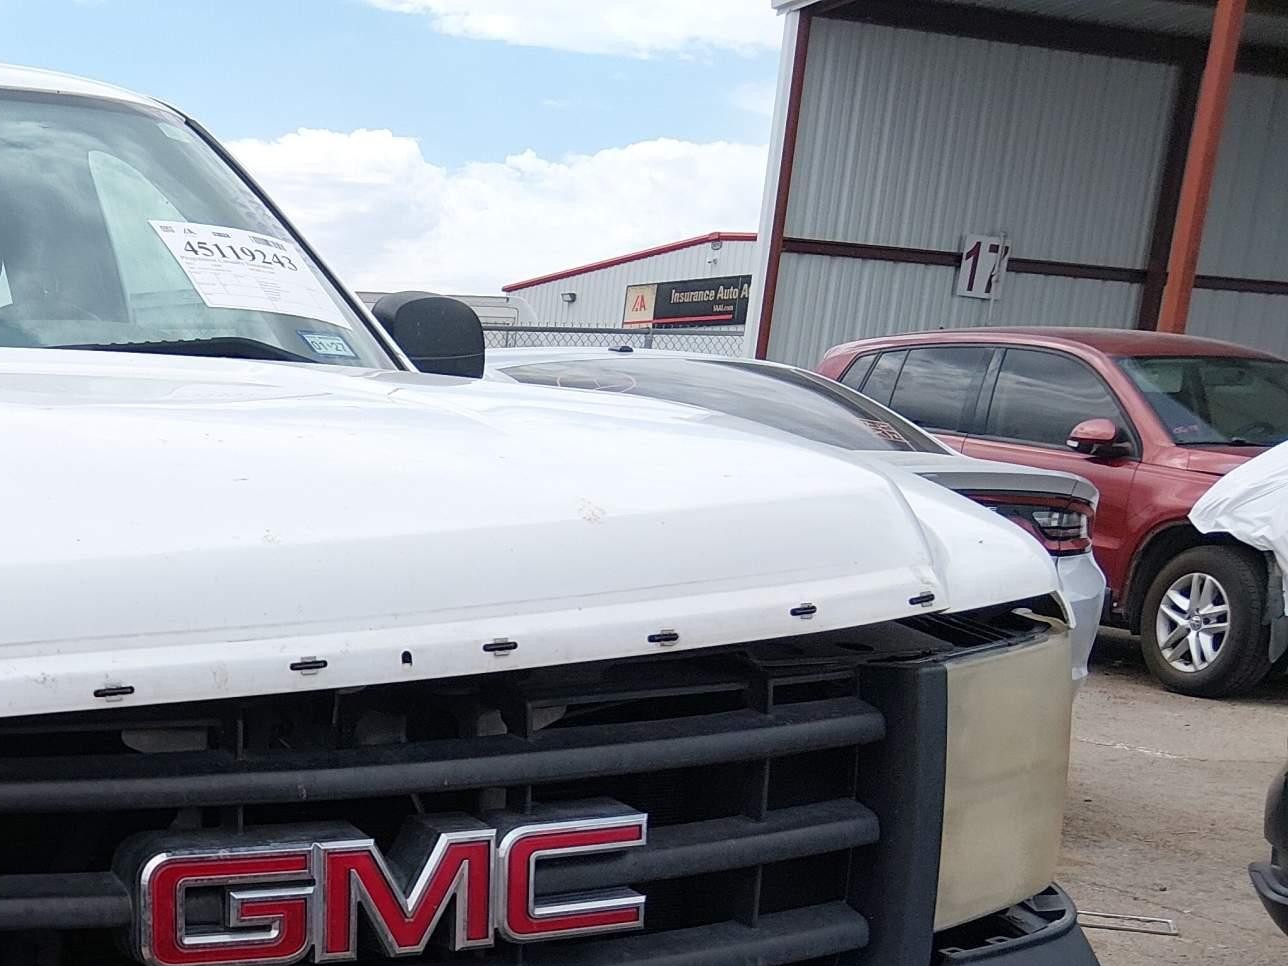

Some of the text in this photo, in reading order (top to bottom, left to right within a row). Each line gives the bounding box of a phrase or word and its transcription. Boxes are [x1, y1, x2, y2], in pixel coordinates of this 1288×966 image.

[184, 240, 298, 272] 45119243
[965, 241, 1010, 294] 17
[670, 289, 715, 304] Insurance
[716, 285, 739, 300] Auto
